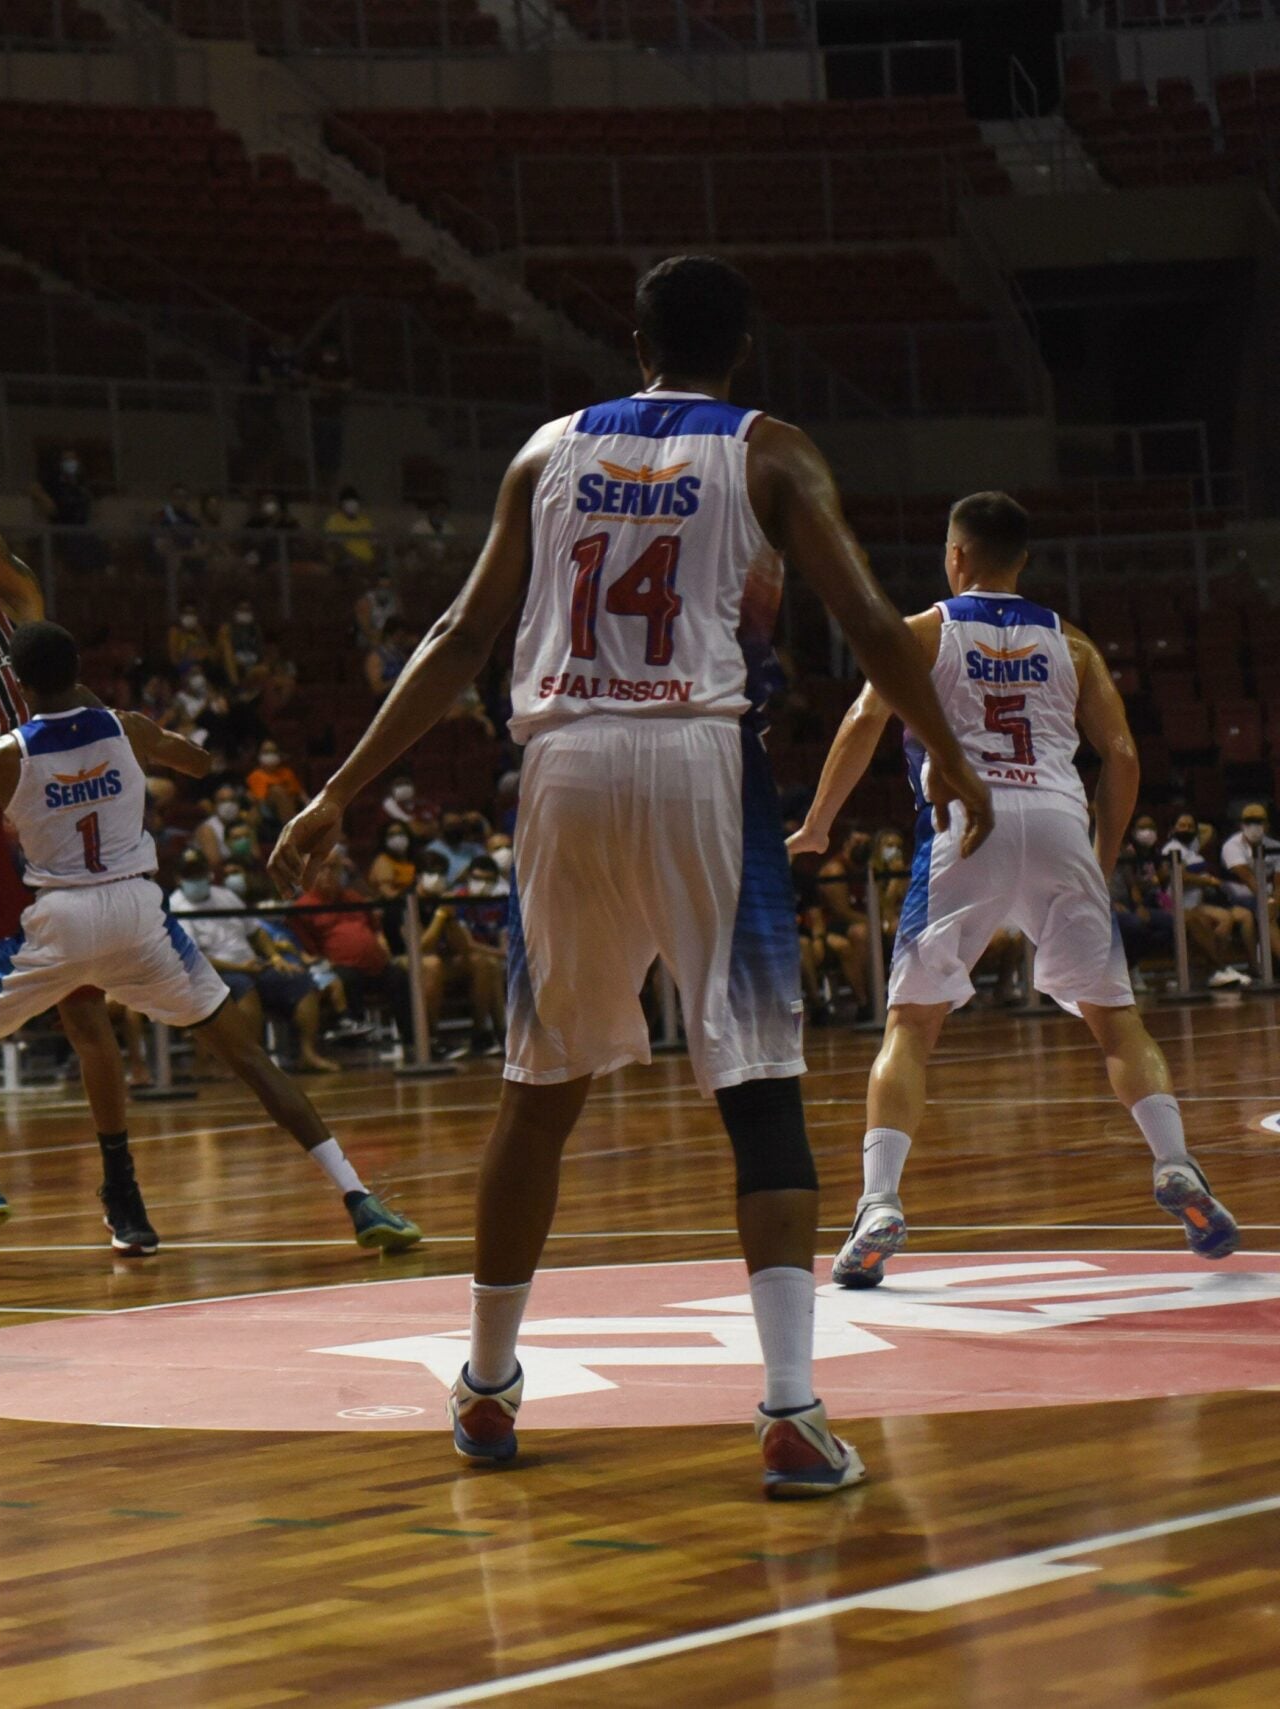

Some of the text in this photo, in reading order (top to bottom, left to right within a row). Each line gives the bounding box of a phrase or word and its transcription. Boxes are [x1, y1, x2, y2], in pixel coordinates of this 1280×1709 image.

[576, 473, 701, 517] SERVIS
[571, 532, 682, 666] 14
[966, 650, 1049, 683] SERVIS
[981, 694, 1037, 766] 5
[45, 769, 123, 809] SERVIS
[76, 811, 107, 874] 1
